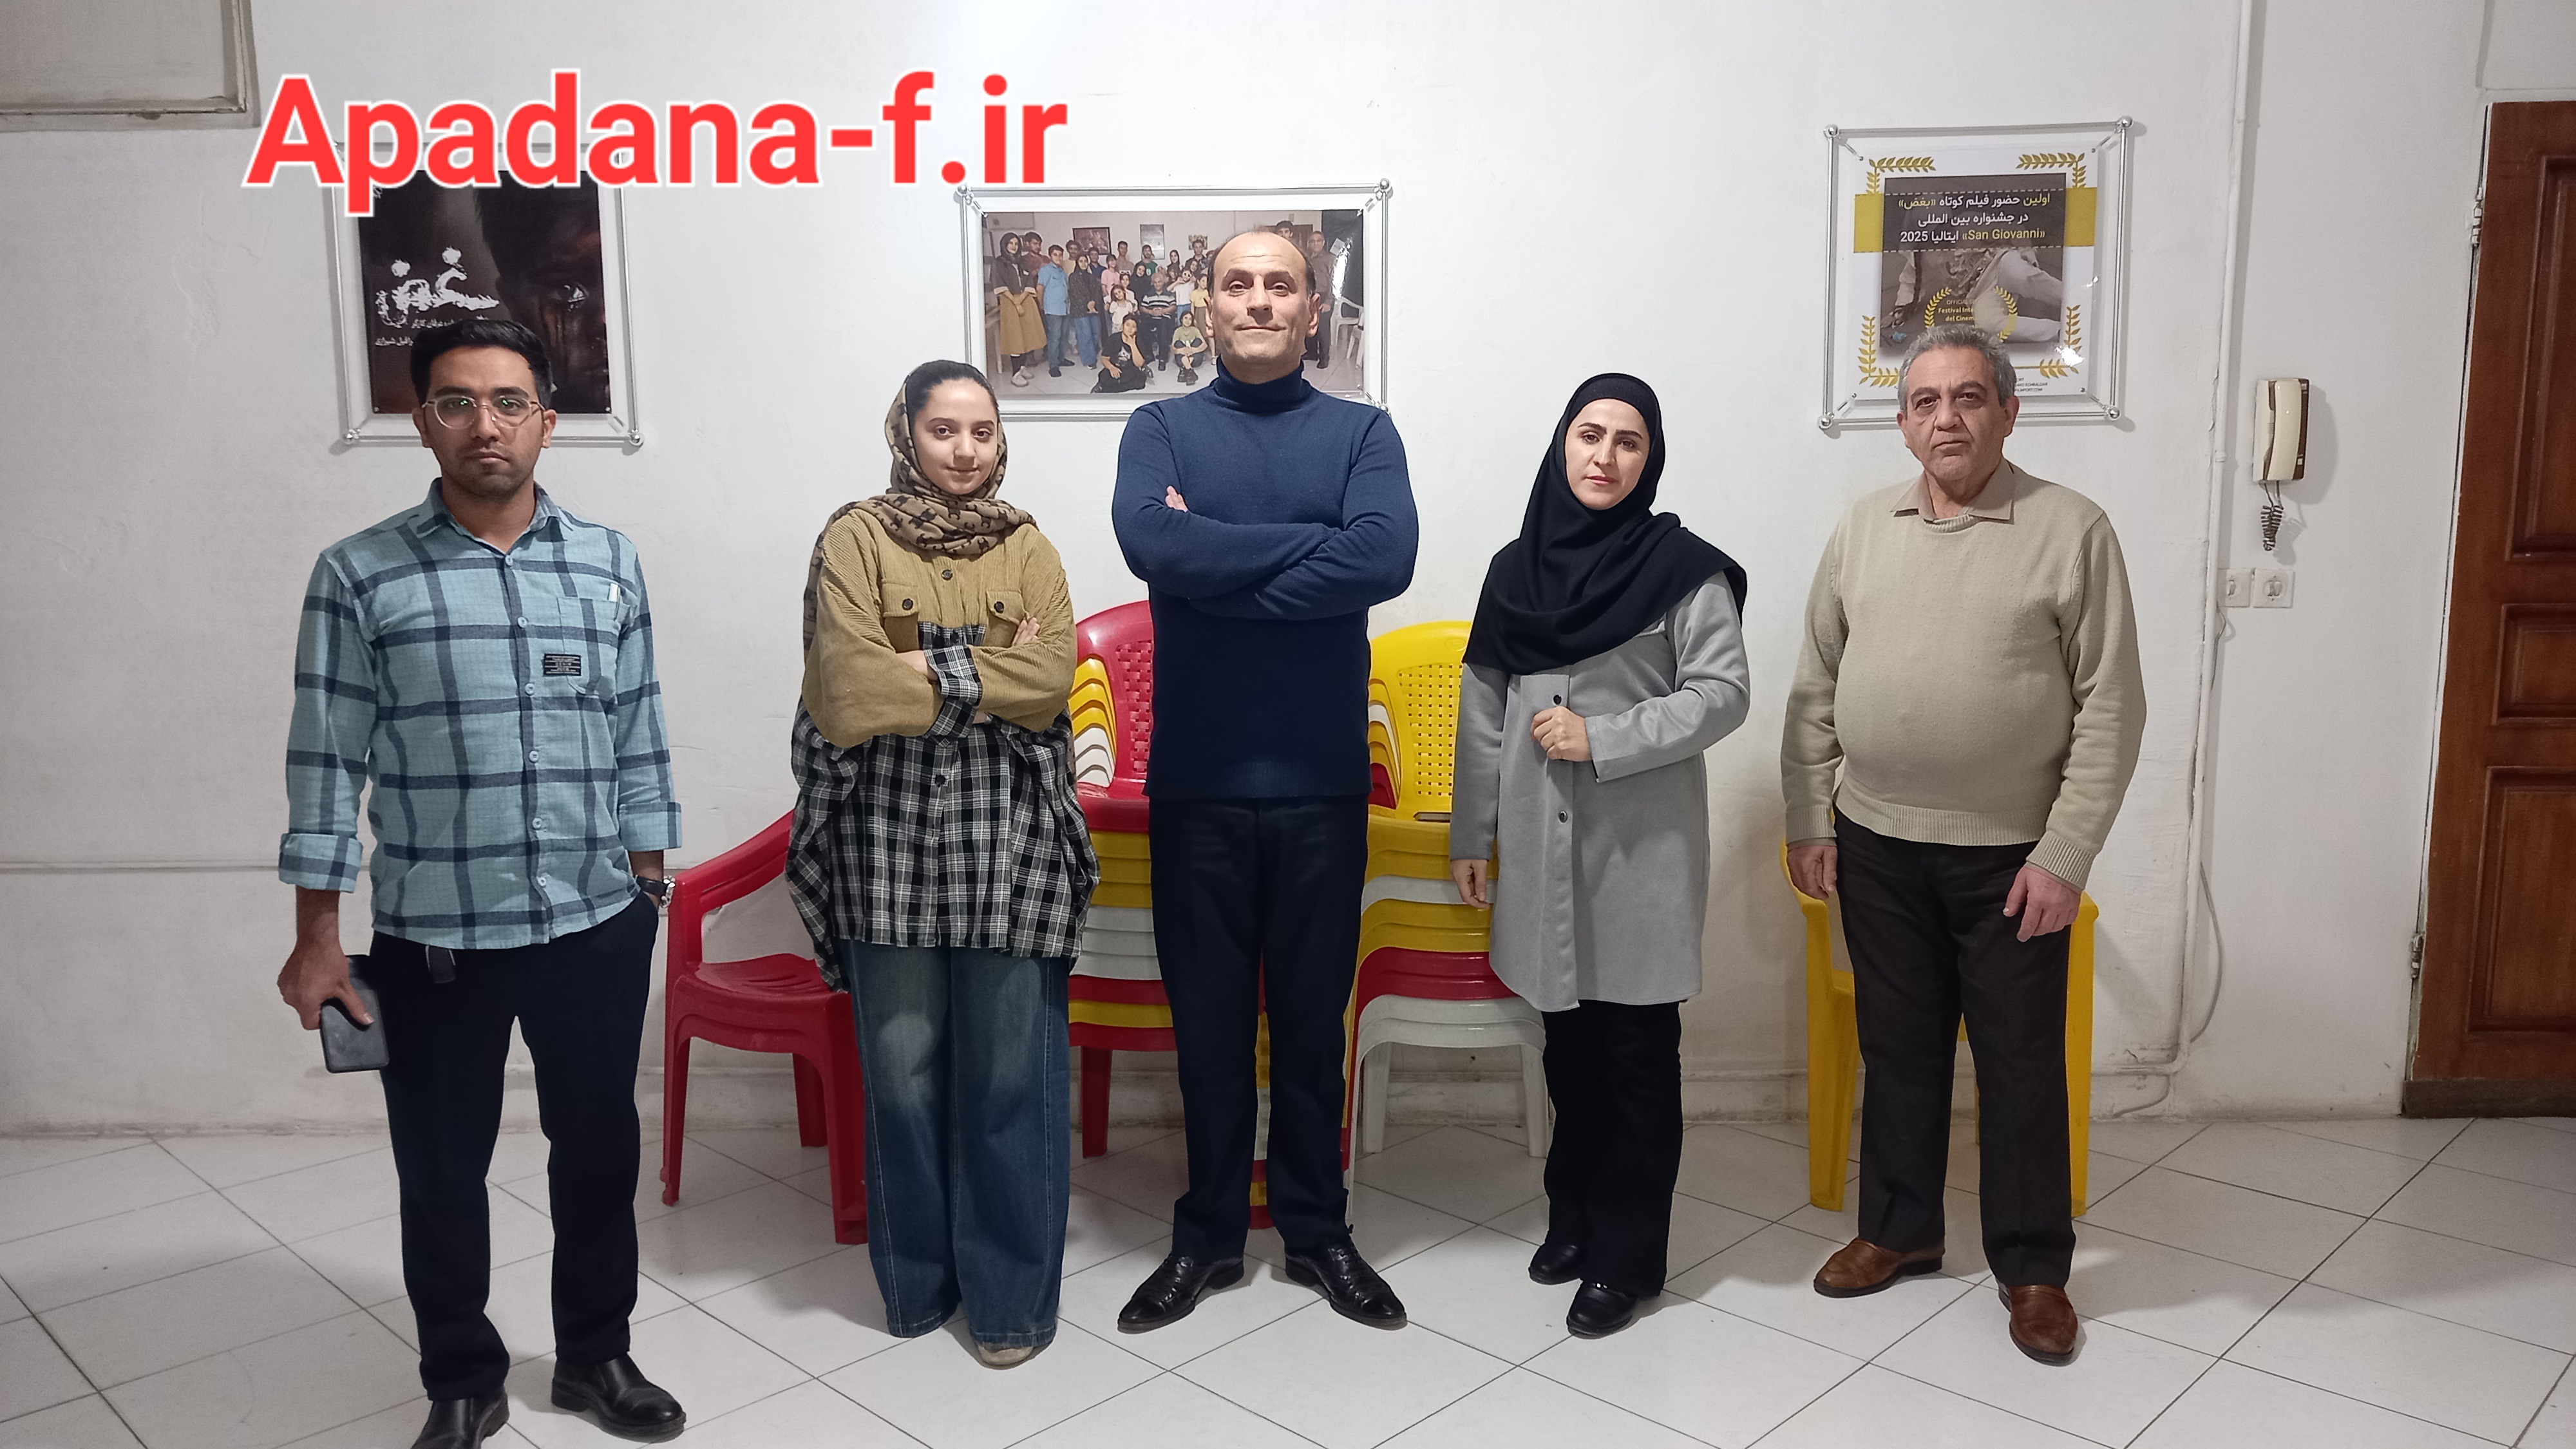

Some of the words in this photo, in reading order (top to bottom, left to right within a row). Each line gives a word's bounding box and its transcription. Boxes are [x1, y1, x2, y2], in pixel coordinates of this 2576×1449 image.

[1939, 195, 1964, 209] کوتاه
[1966, 194, 1989, 208] فیلم
[1991, 194, 2020, 208] حضور
[2023, 193, 2050, 206] اولین
[1918, 213, 1948, 227] المللی
[1951, 215, 1971, 225] بین
[1973, 211, 2015, 225] جشنواره
[2017, 213, 2029, 225] در
[1900, 231, 1928, 242] 2025
[1931, 230, 1959, 243] ایتالیا
